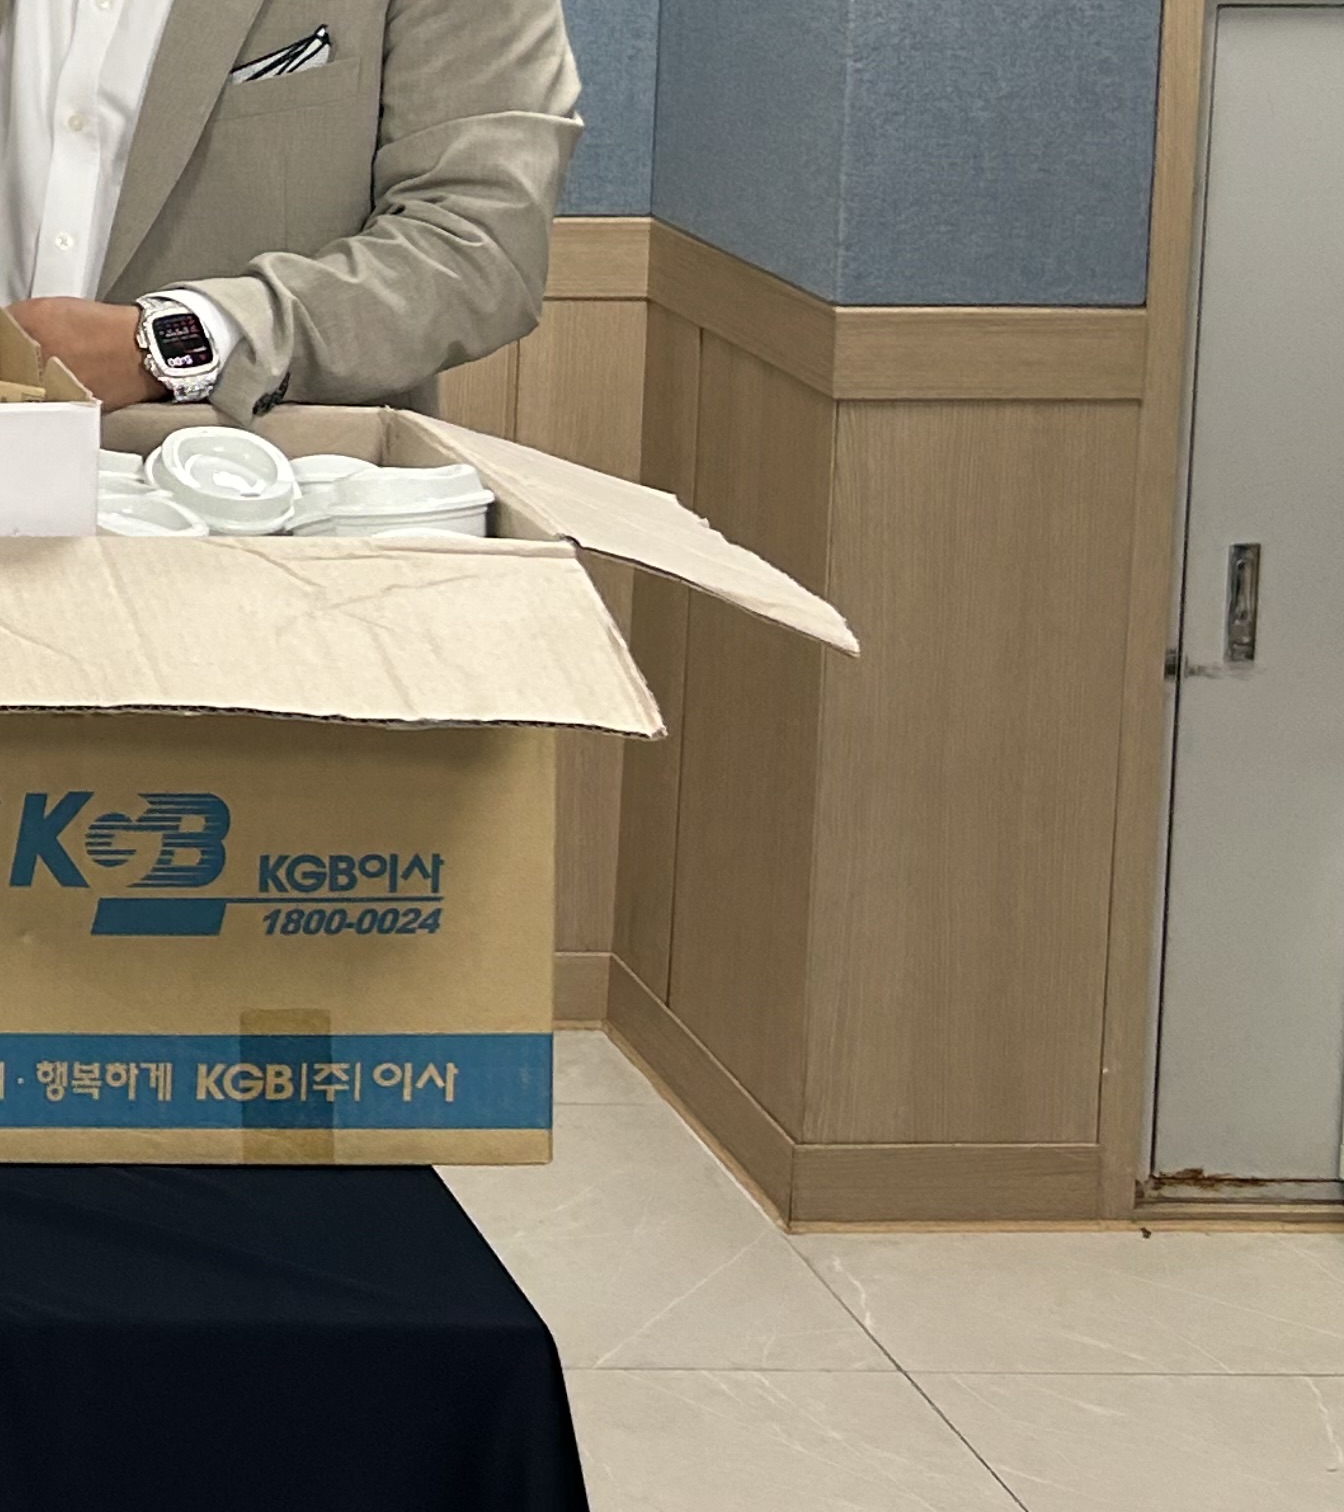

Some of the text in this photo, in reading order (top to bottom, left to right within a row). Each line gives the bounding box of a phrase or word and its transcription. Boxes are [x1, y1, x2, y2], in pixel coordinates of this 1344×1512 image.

[9, 792, 231, 887] KGB
[258, 852, 444, 894] KGB이사
[262, 907, 442, 936] 1800-0024
[36, 1061, 173, 1102] 행복하게
[372, 1062, 459, 1103] 이사
